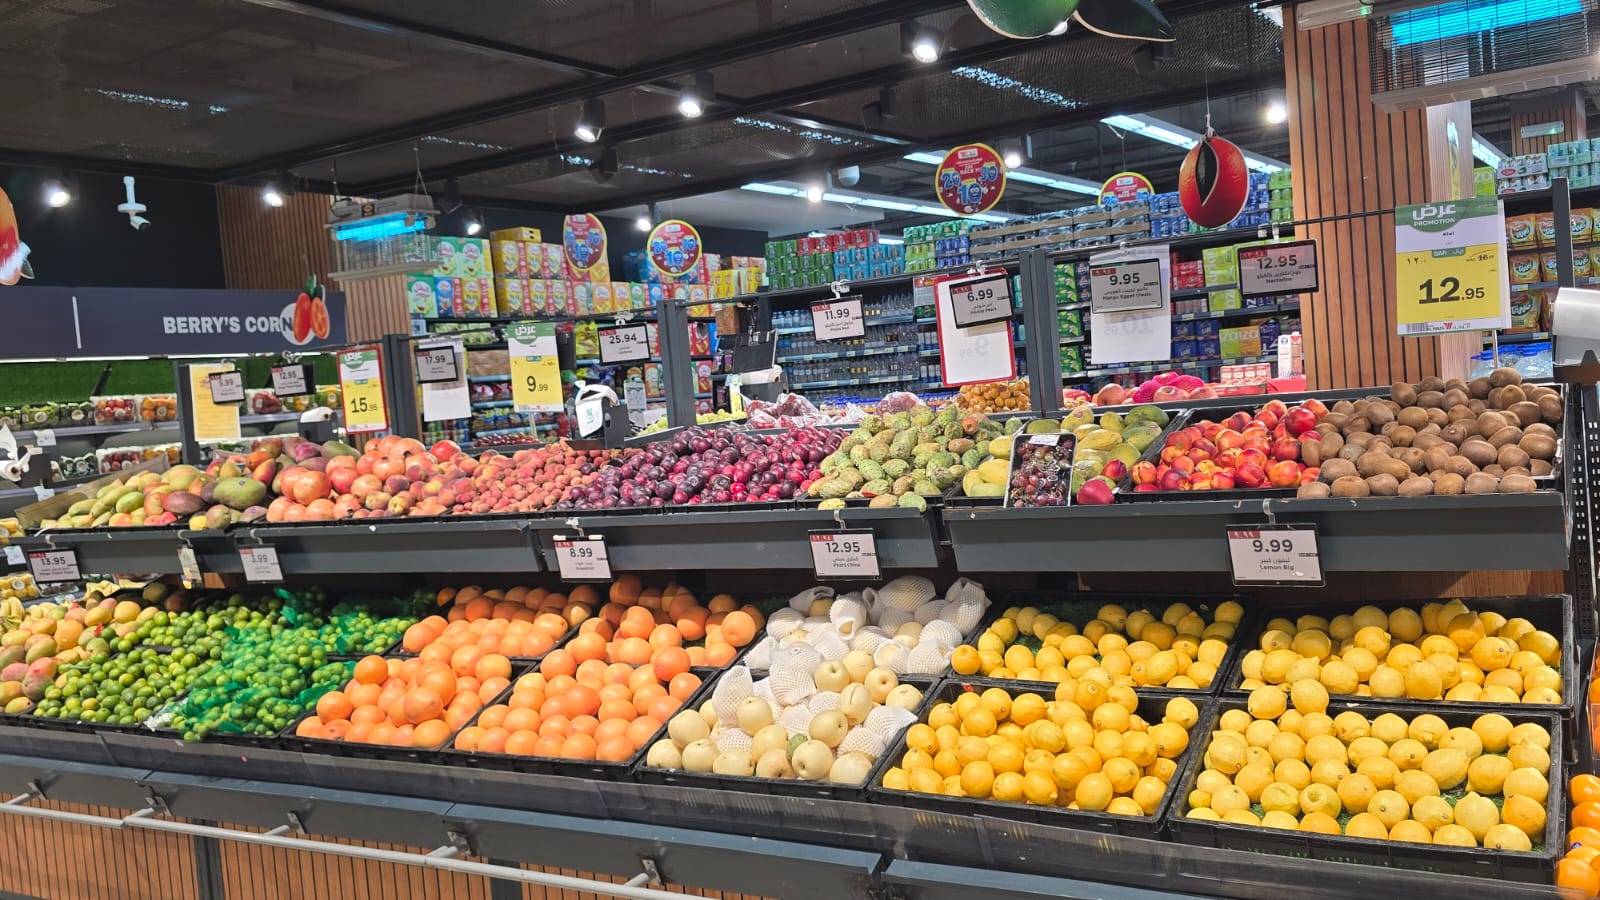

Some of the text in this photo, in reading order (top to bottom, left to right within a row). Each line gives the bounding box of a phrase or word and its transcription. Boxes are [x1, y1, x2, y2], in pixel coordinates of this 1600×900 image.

[958, 182, 983, 205] 10
[1412, 204, 1456, 220] عرض
[1413, 217, 1455, 228] PROMOTION
[665, 250, 684, 267] 10
[1257, 254, 1298, 270] 12.95
[1109, 272, 1140, 286] 9.95
[967, 287, 994, 302] 6.99
[1418, 276, 1485, 305] 12.95
[825, 308, 850, 320] 11.99
[163, 315, 241, 334] BERRY'S
[608, 333, 638, 345] 25.94
[425, 354, 446, 365] 17.99
[527, 376, 549, 393] 9.99
[569, 547, 593, 558] 8.99
[825, 541, 861, 553] 12.95
[1252, 539, 1293, 553] 9.99
[40, 556, 66, 566] 13.95
